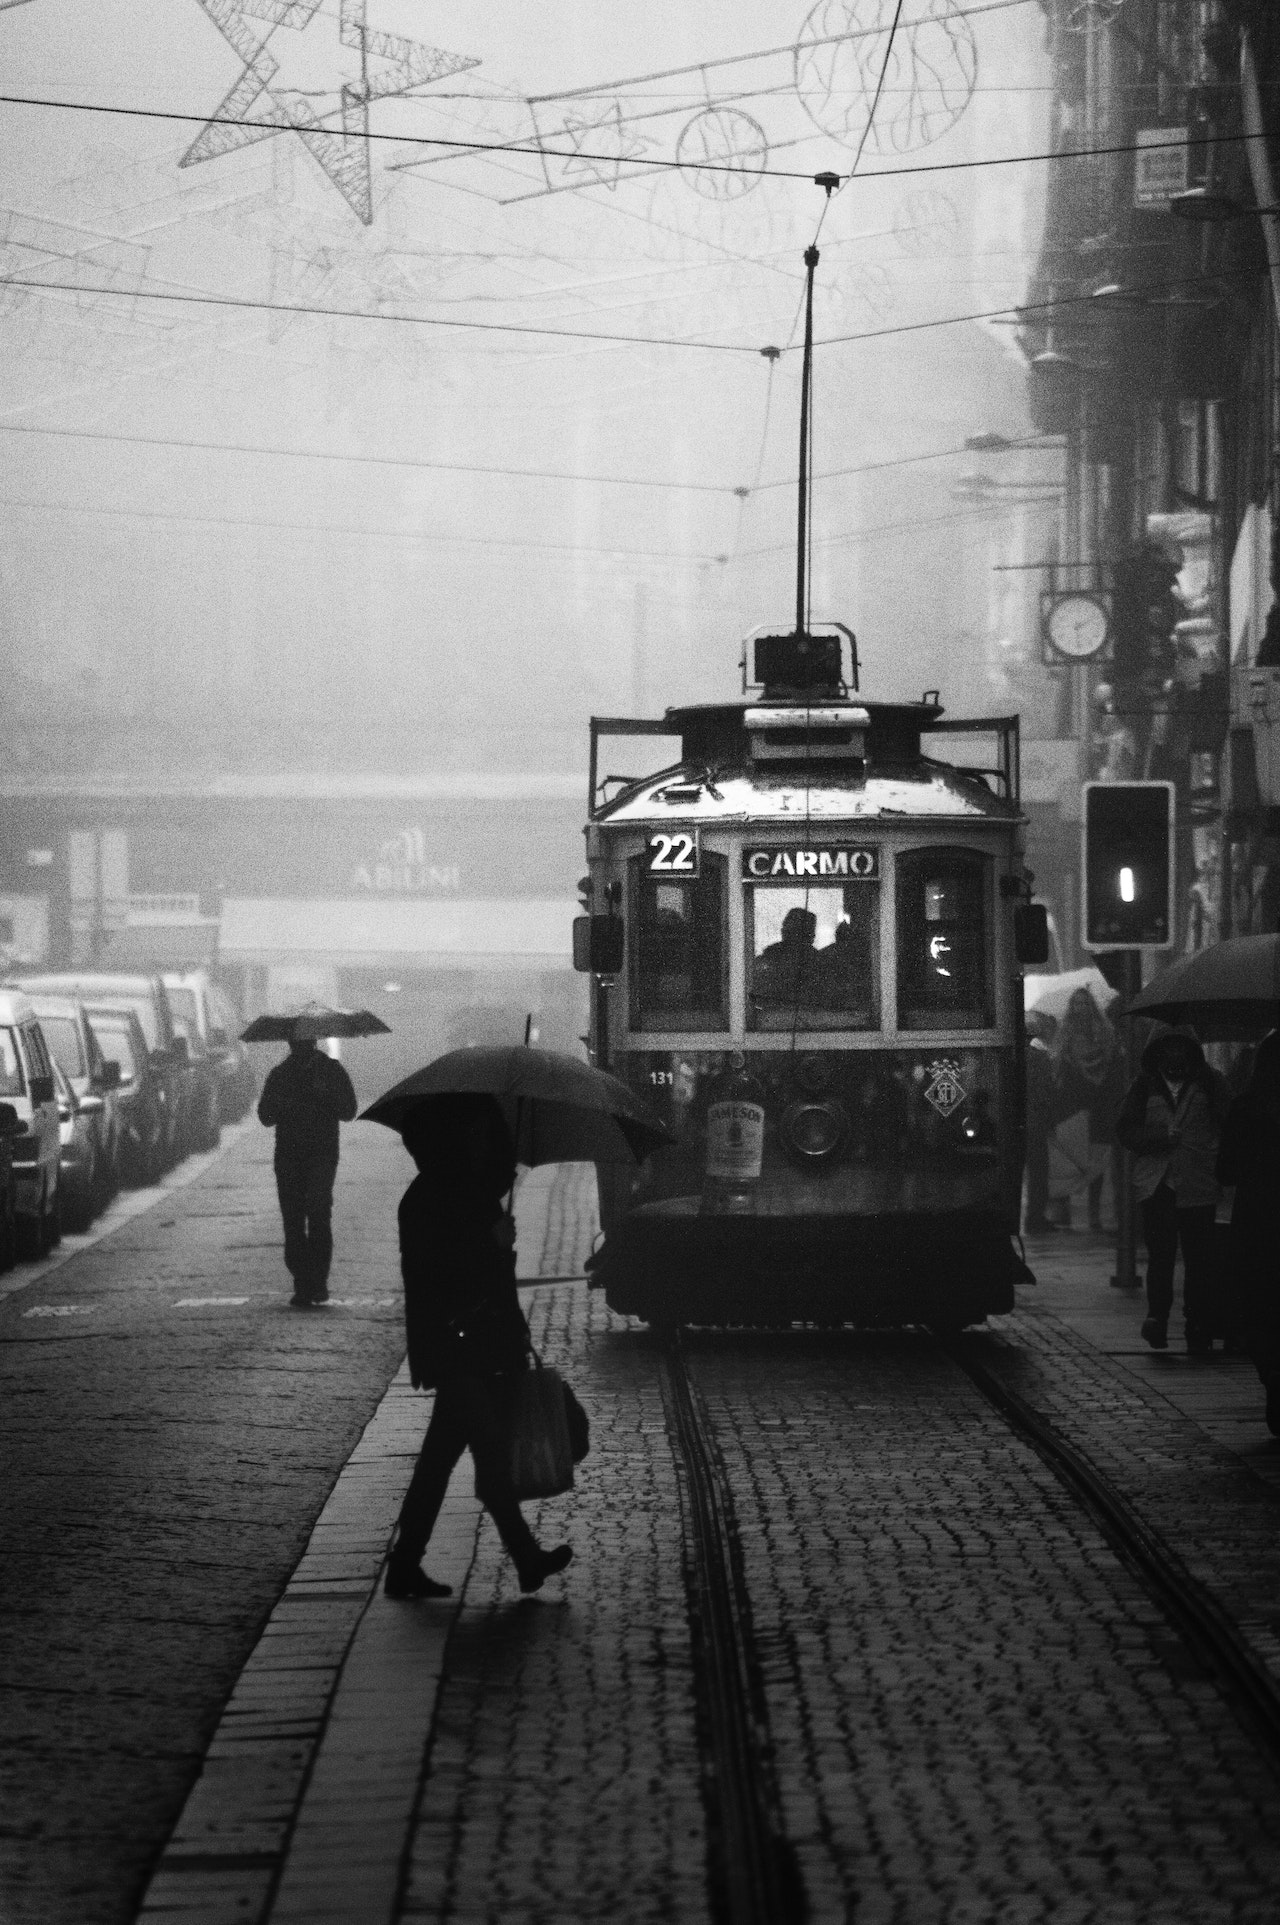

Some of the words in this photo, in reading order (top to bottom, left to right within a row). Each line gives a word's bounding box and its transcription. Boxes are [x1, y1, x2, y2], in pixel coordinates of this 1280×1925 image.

[650, 830, 694, 870] 22
[748, 851, 874, 875] CARMO
[649, 1071, 673, 1085] 131
